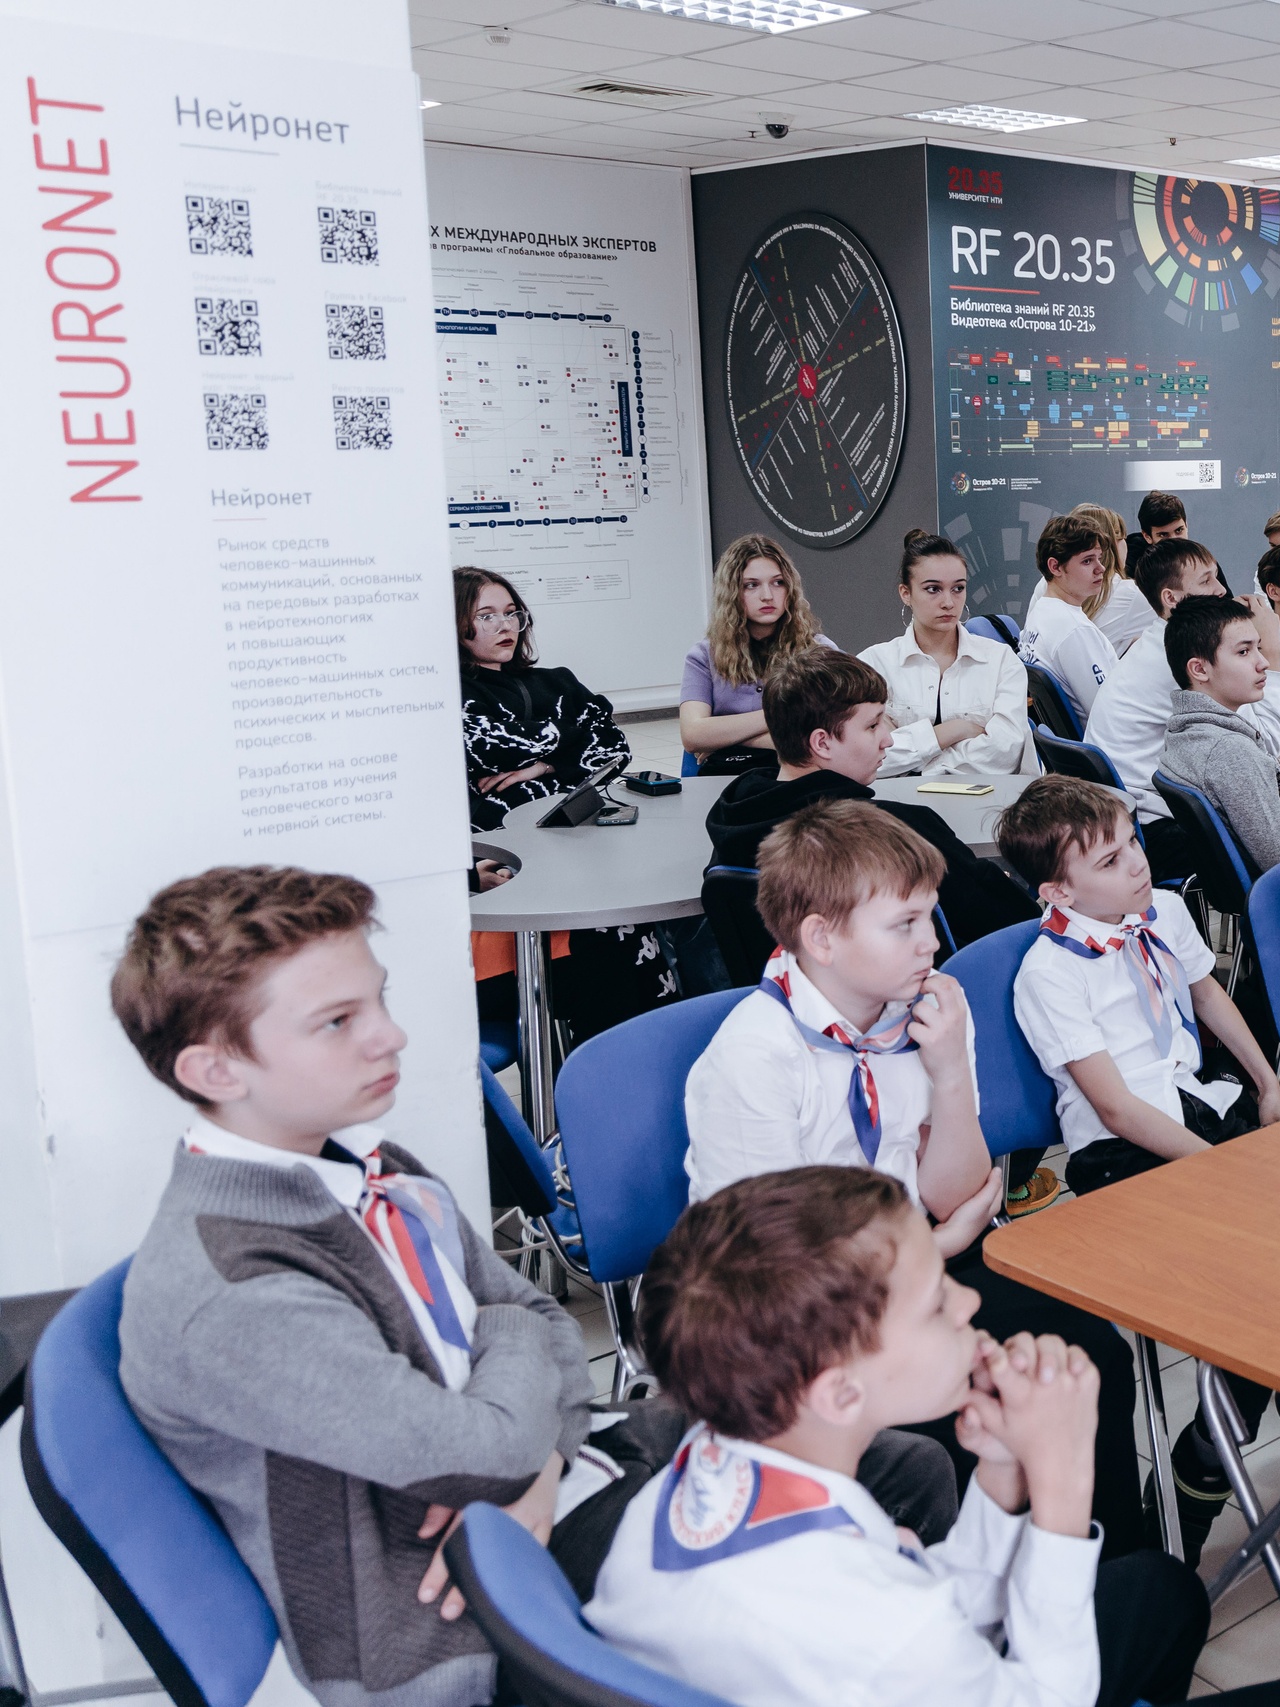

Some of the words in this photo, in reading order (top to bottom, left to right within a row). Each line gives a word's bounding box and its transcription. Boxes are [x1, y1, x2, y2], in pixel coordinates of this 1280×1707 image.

[175, 94, 350, 144] Нейронет
[948, 166, 1002, 196] 20.35
[949, 192, 989, 203] УНИВЕРСИТЕТ
[444, 226, 578, 248] МЕЖДУНАРОДНЫХ
[582, 236, 657, 253] ЭКСПЕРТОВ
[441, 243, 494, 255] программы
[496, 245, 556, 258] «Глобальное
[558, 250, 618, 262] образование»
[952, 225, 1001, 275] RF
[1013, 231, 1115, 285] 20.35
[26, 76, 142, 504] NEURONET
[951, 297, 1012, 314] Библиотека
[1014, 300, 1050, 316] знаний
[1052, 303, 1065, 316] RF
[1068, 304, 1095, 318] 20.35
[951, 313, 1006, 330] Видеотека
[1009, 316, 1055, 332] «Острова
[1059, 320, 1096, 333] 10-21»
[875, 458, 890, 489] КООРДИНАТ
[886, 437, 895, 458] УСПЕХА
[891, 394, 899, 437] ГЛОБАЛЬНОГО
[972, 478, 991, 487] Остров
[991, 478, 1006, 486] 10-21
[210, 488, 313, 509] Нейронет
[218, 538, 266, 552] Рынок
[272, 537, 329, 551] средств
[220, 554, 376, 572] человеко-машинных
[221, 573, 334, 592] коммуникаций,
[340, 572, 423, 586] основанных
[223, 601, 241, 611] на
[247, 594, 328, 611] передовых
[334, 590, 420, 607] разработках
[225, 620, 232, 631] в
[239, 612, 373, 631] нейротехнологиях
[227, 640, 236, 651] и
[242, 632, 346, 651] повышающих
[229, 651, 347, 672] продуктивность
[230, 669, 384, 691] человеко-машинных
[389, 664, 439, 679] систем,
[232, 687, 383, 711] производительность
[234, 710, 326, 731] психических
[331, 711, 340, 721] и
[345, 699, 445, 719] мыслительных
[235, 731, 317, 750] процессов.
[238, 759, 323, 780] Разработки
[328, 758, 345, 769] на
[350, 751, 398, 767] основе
[240, 779, 328, 800] результатов
[333, 769, 397, 789] изучения
[242, 795, 349, 818] человеческого
[354, 789, 393, 805] мозга
[243, 826, 252, 837] и
[258, 817, 319, 836] нервной
[324, 808, 387, 826] системы.
